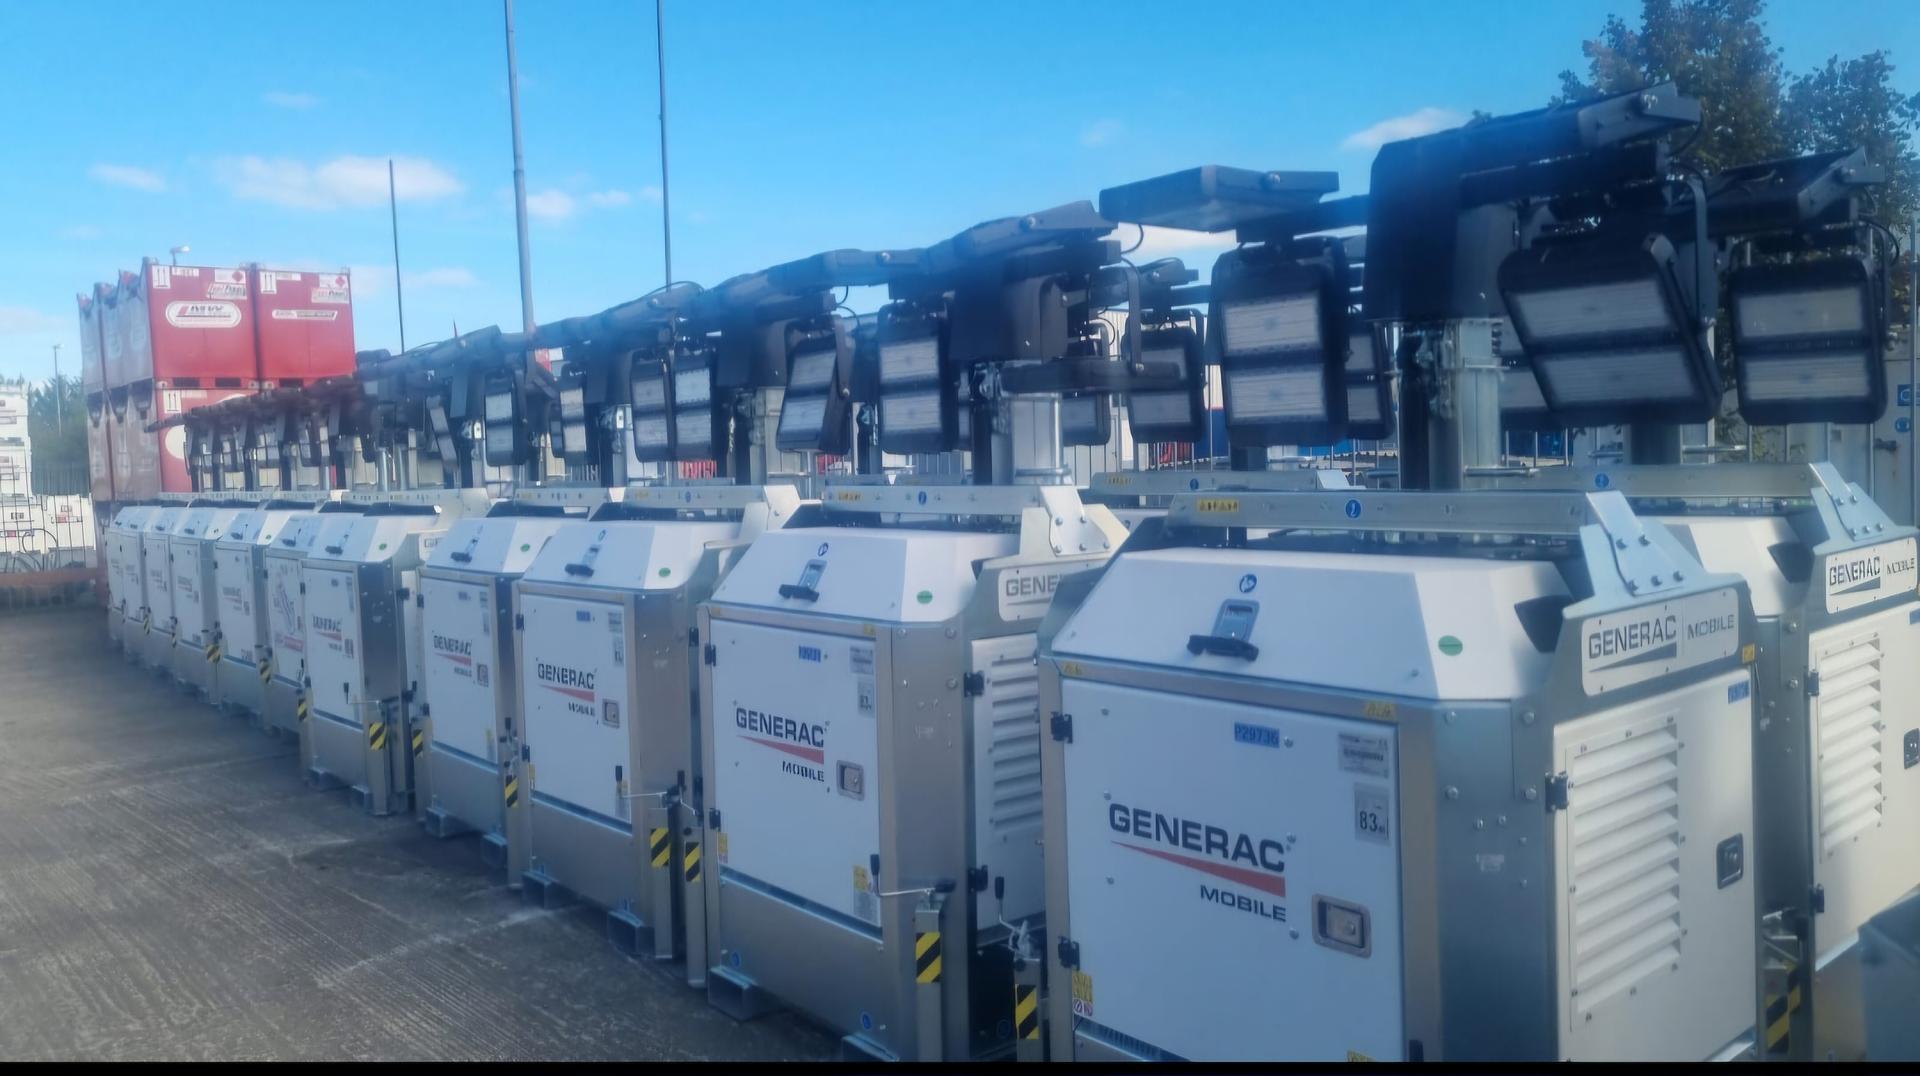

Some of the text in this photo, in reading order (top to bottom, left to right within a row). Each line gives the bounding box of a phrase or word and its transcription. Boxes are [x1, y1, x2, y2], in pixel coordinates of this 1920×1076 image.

[1006, 575, 1059, 596] GENE
[1829, 556, 1915, 586] GENERAC MOBILE
[1589, 614, 1735, 659] GENERAC MOBILE
[537, 663, 595, 690] GENERAC
[736, 706, 824, 748] GENERAC
[782, 760, 825, 782] MOBILE
[1360, 810, 1378, 832] 83
[1109, 803, 1285, 873] GENERAC
[1200, 884, 1286, 922] MOBILE
